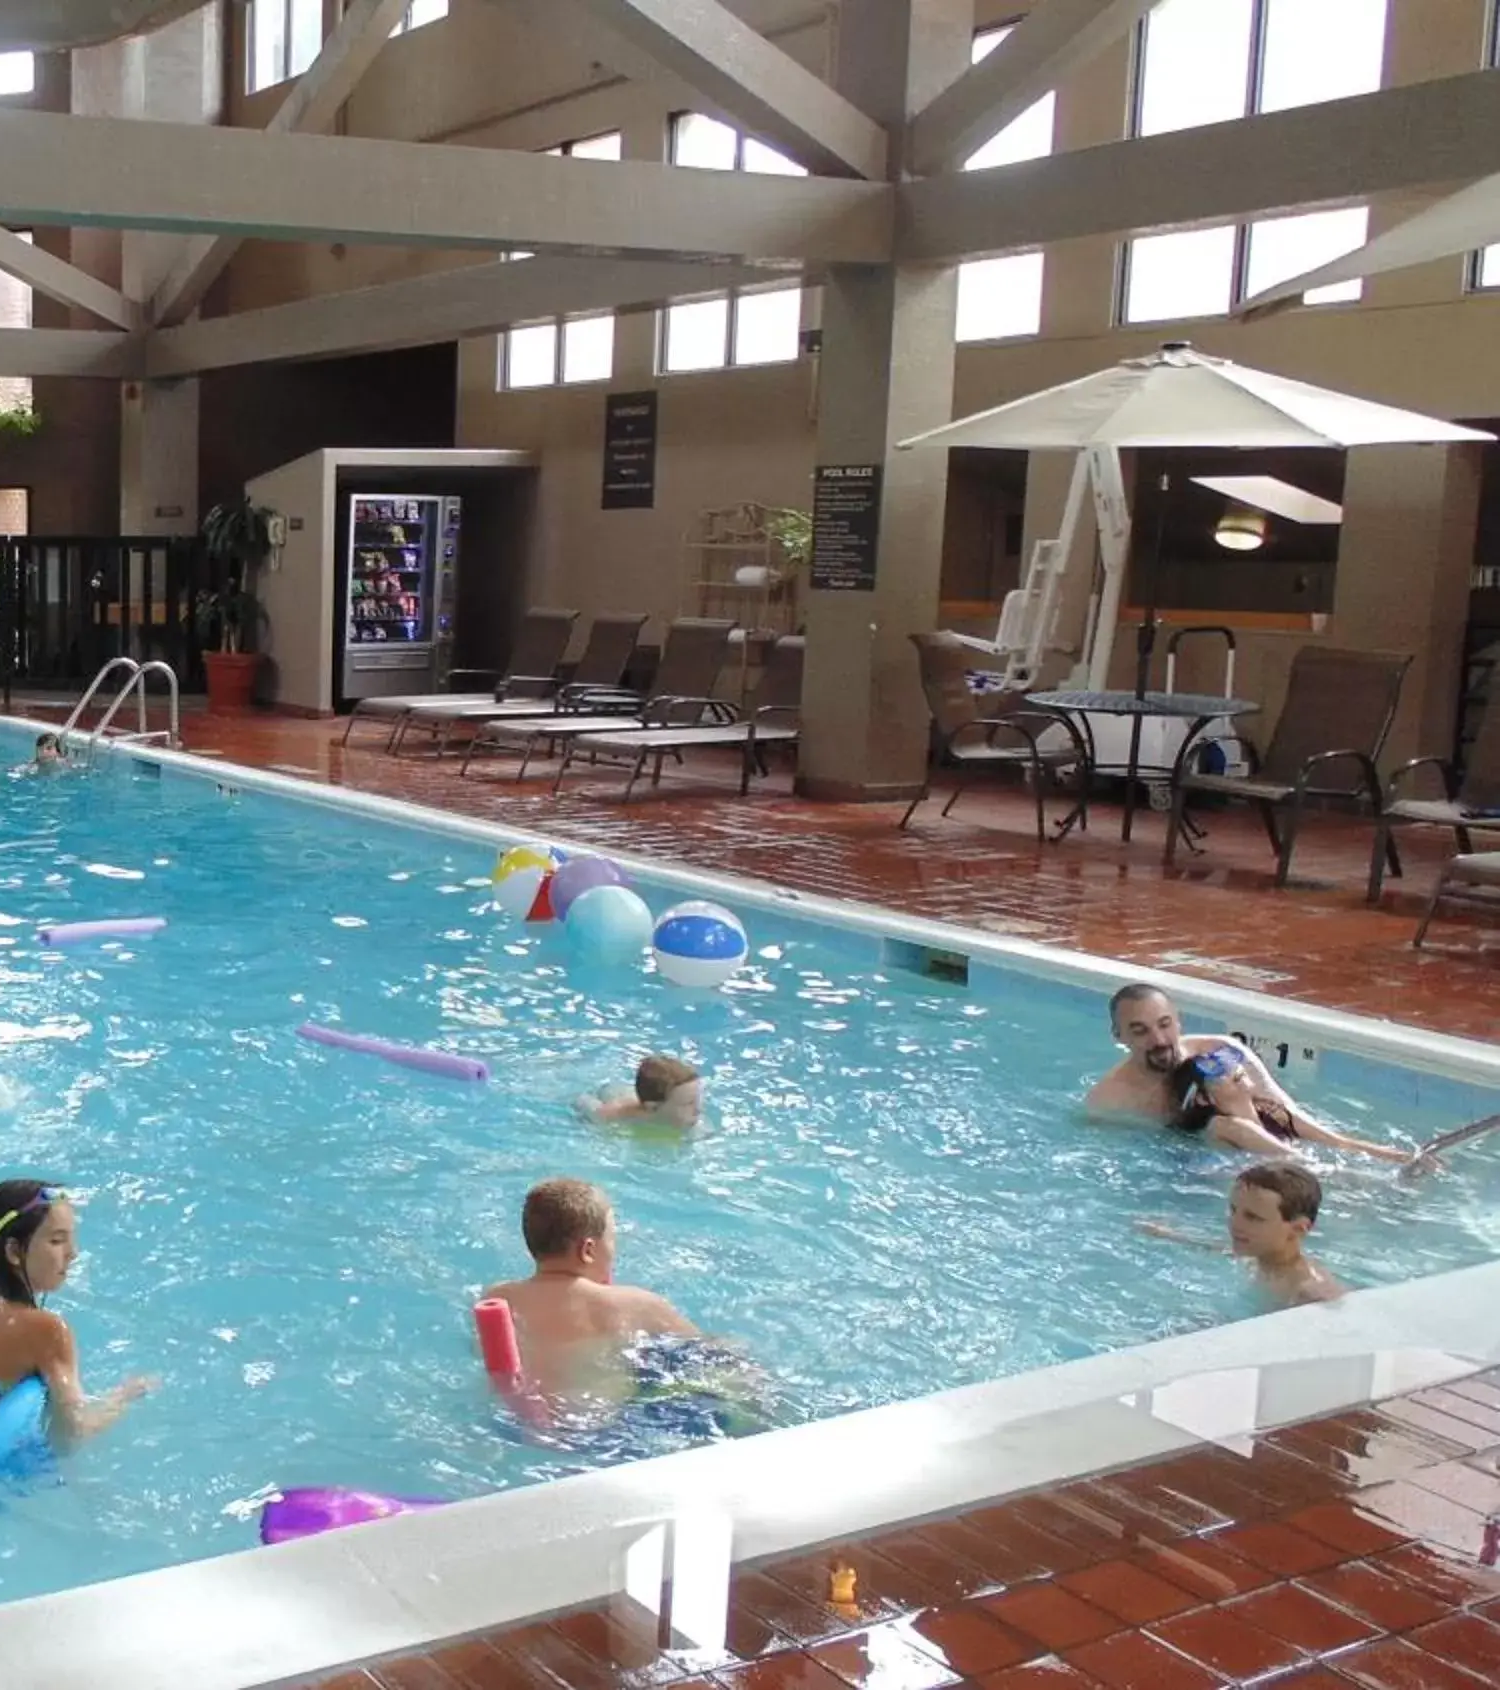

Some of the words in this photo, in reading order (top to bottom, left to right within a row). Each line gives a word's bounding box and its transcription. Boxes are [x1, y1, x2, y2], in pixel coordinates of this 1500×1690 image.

[823, 468, 843, 477] POOL
[845, 467, 873, 477] RULES
[1276, 1043, 1288, 1068] 1
